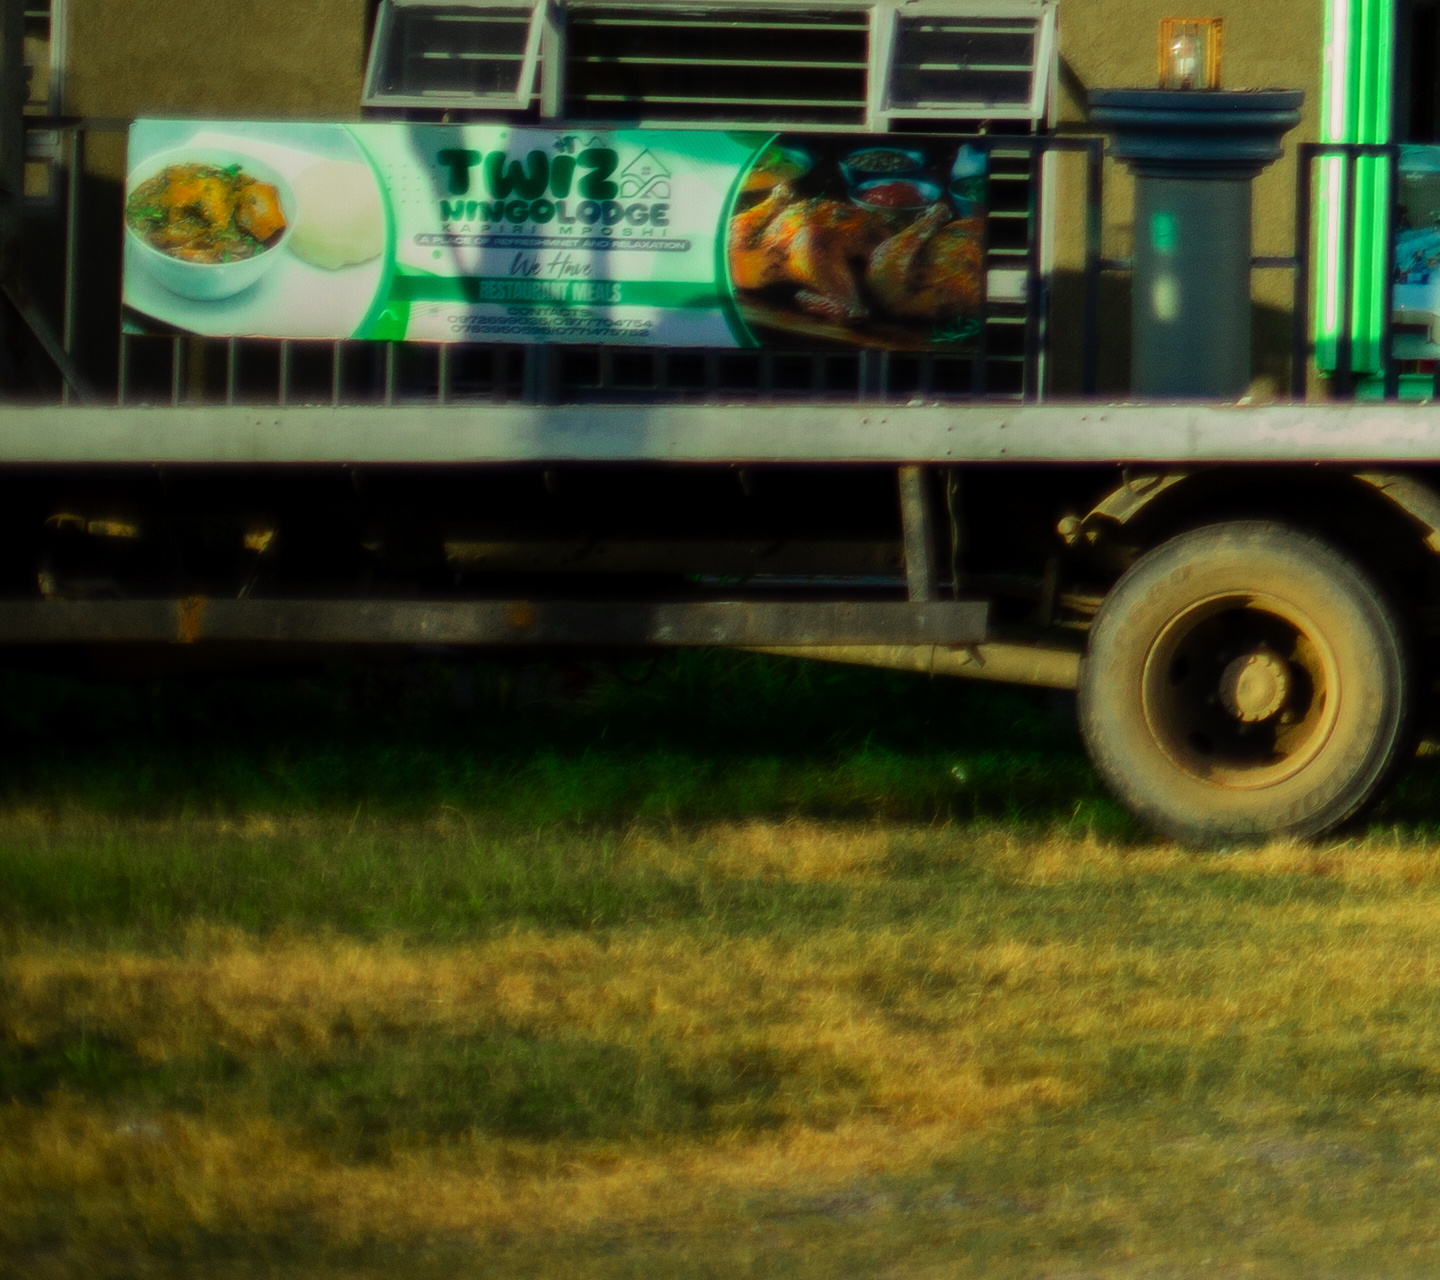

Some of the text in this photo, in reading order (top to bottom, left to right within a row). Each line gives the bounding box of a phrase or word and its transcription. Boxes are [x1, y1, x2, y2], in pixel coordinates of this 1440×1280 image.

[559, 227, 668, 237] MPOSHI
[612, 241, 686, 250] RELAXATION
[511, 251, 593, 279] We Have
[479, 279, 622, 302] RESTAURANT MEALS
